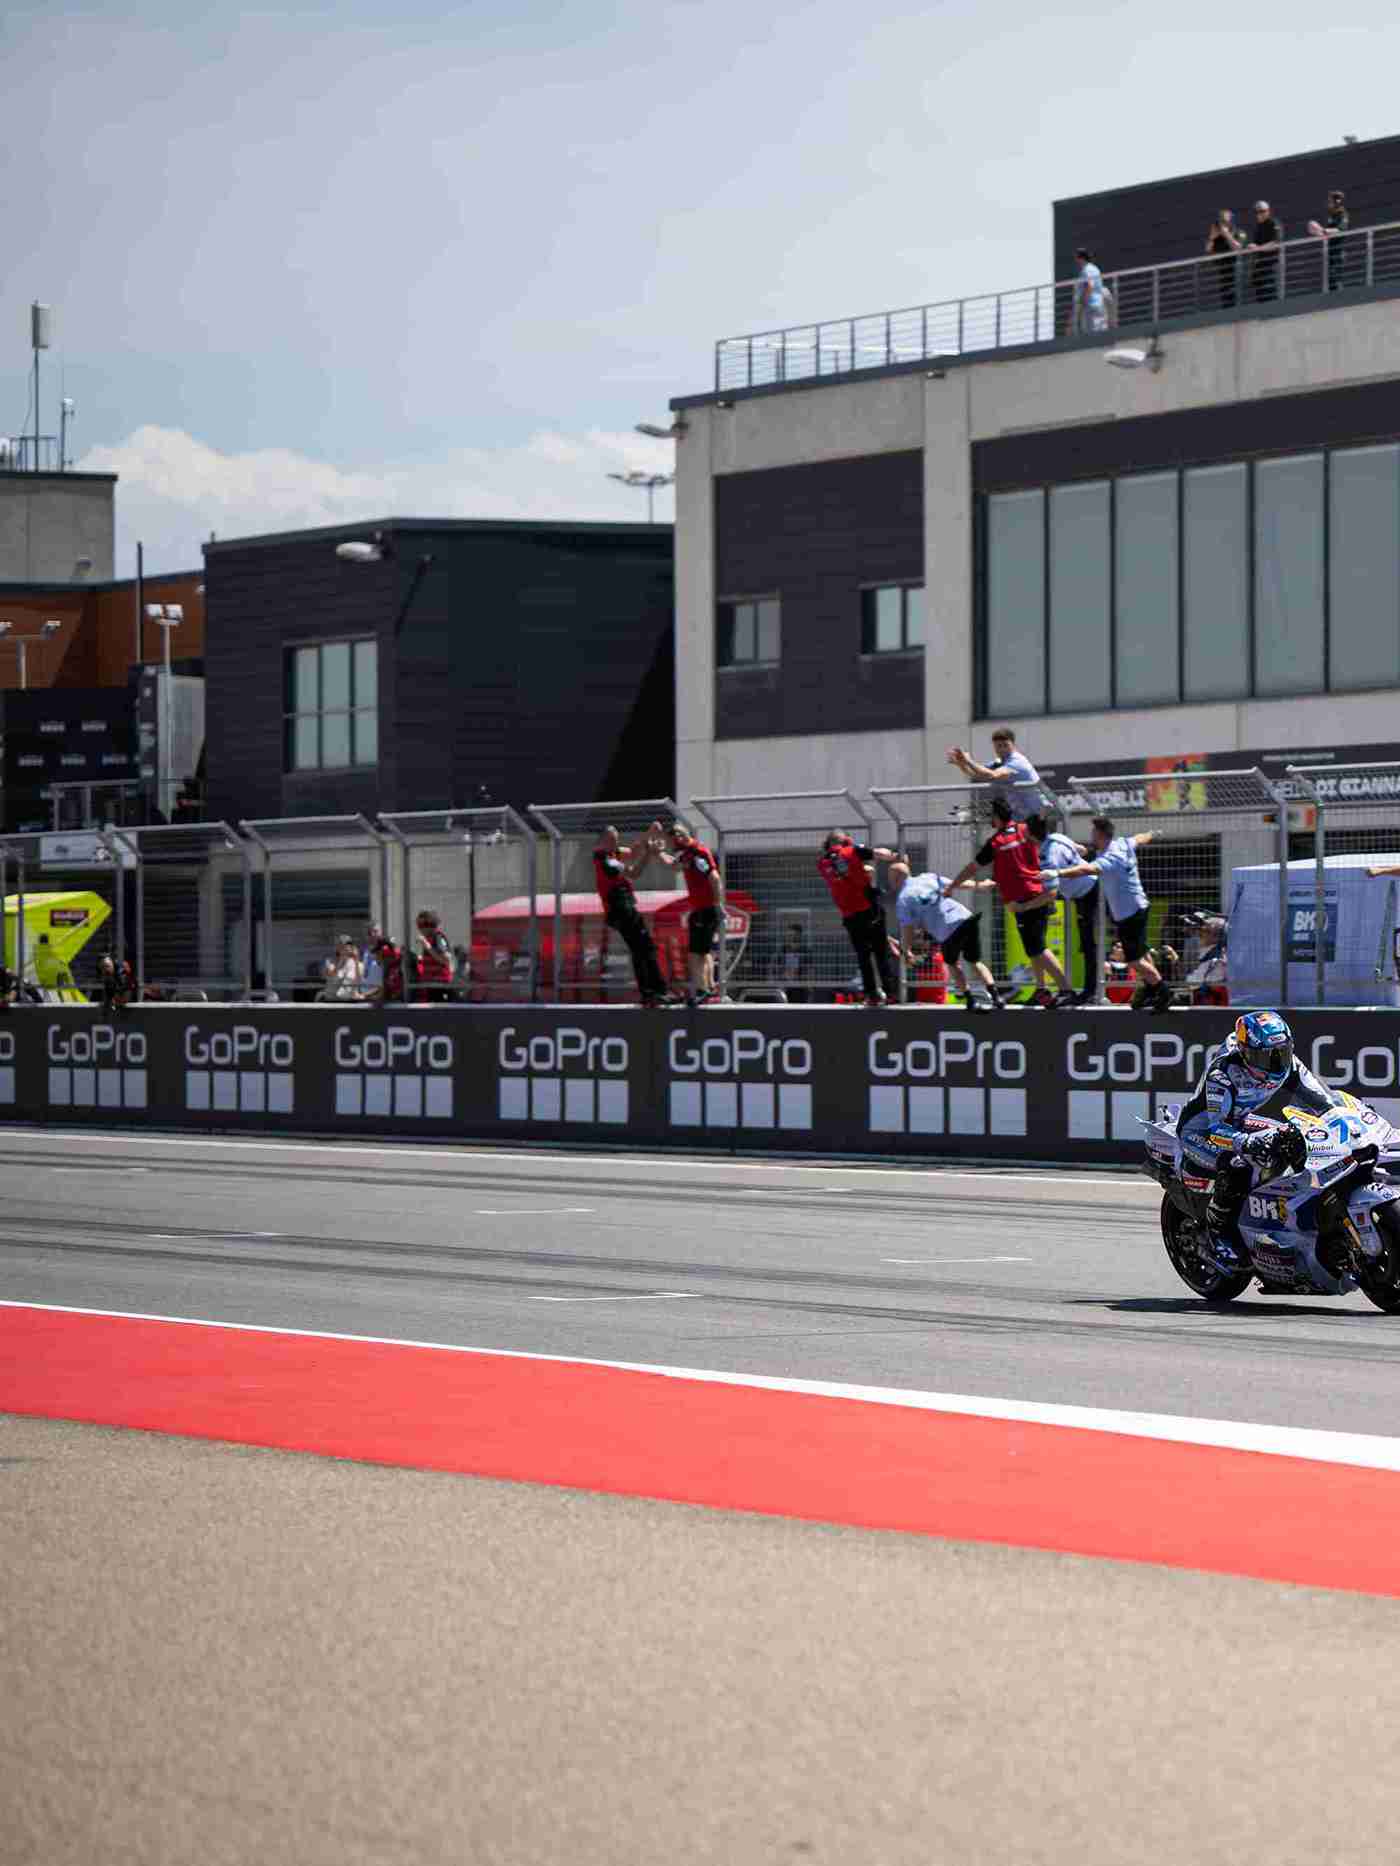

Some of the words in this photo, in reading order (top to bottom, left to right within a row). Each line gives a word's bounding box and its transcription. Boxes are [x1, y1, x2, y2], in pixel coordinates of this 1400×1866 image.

[1293, 911, 1328, 932] BK
[48, 1026, 147, 1063] GoPro
[186, 1026, 294, 1066] GoPro
[335, 1027, 453, 1069] GoPro
[500, 1028, 628, 1072] GoPro
[669, 1029, 812, 1075] GoPro
[868, 1030, 1027, 1079] GoPro
